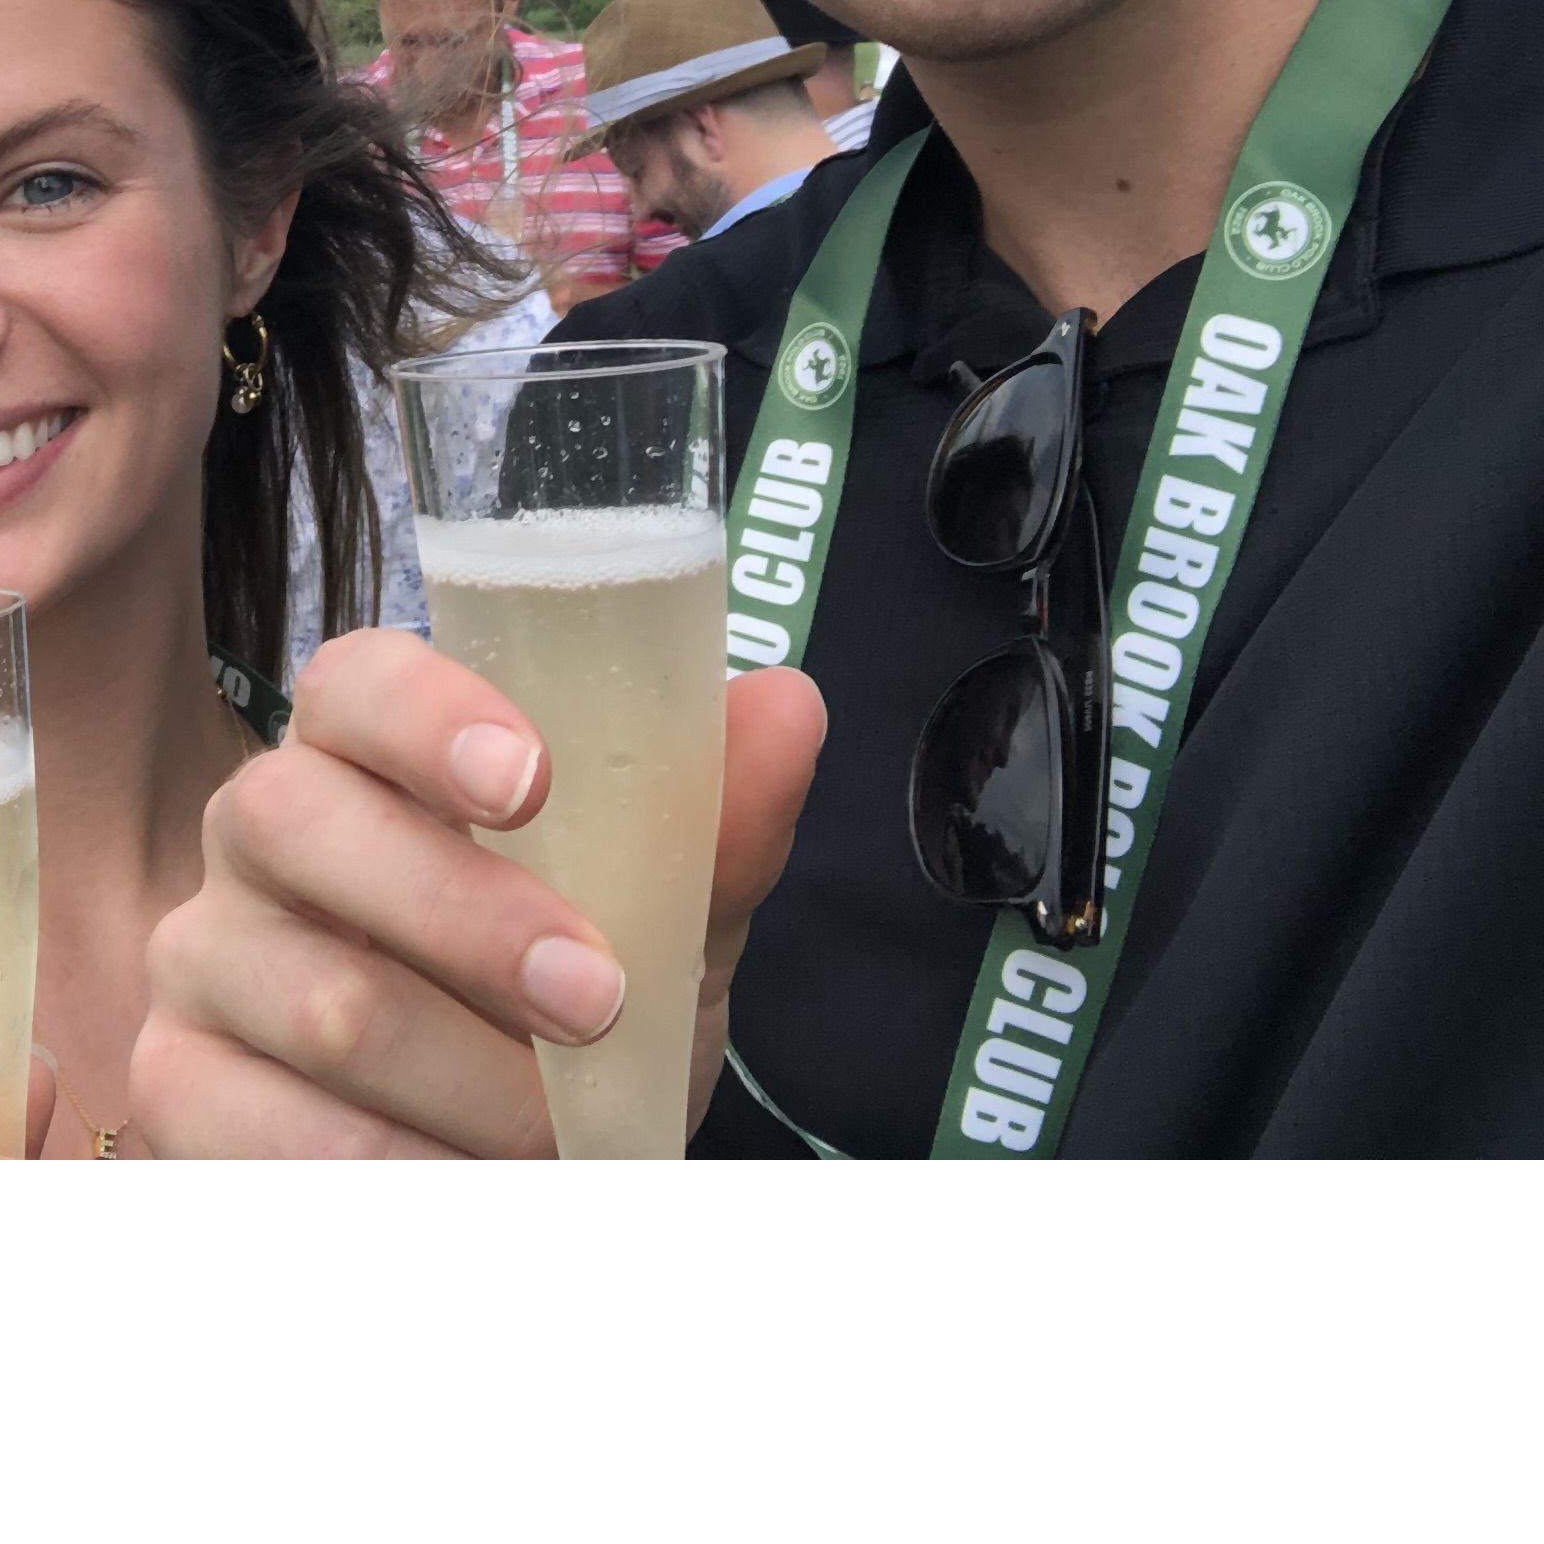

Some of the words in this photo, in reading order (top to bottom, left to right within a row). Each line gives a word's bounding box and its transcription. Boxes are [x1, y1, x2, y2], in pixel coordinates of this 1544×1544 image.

[1170, 314, 1282, 474] OAK
[731, 438, 833, 606] CLUB
[1112, 474, 1236, 748] BROOK
[960, 949, 1088, 1152] CLUB
[99, 1127, 117, 1159] E
